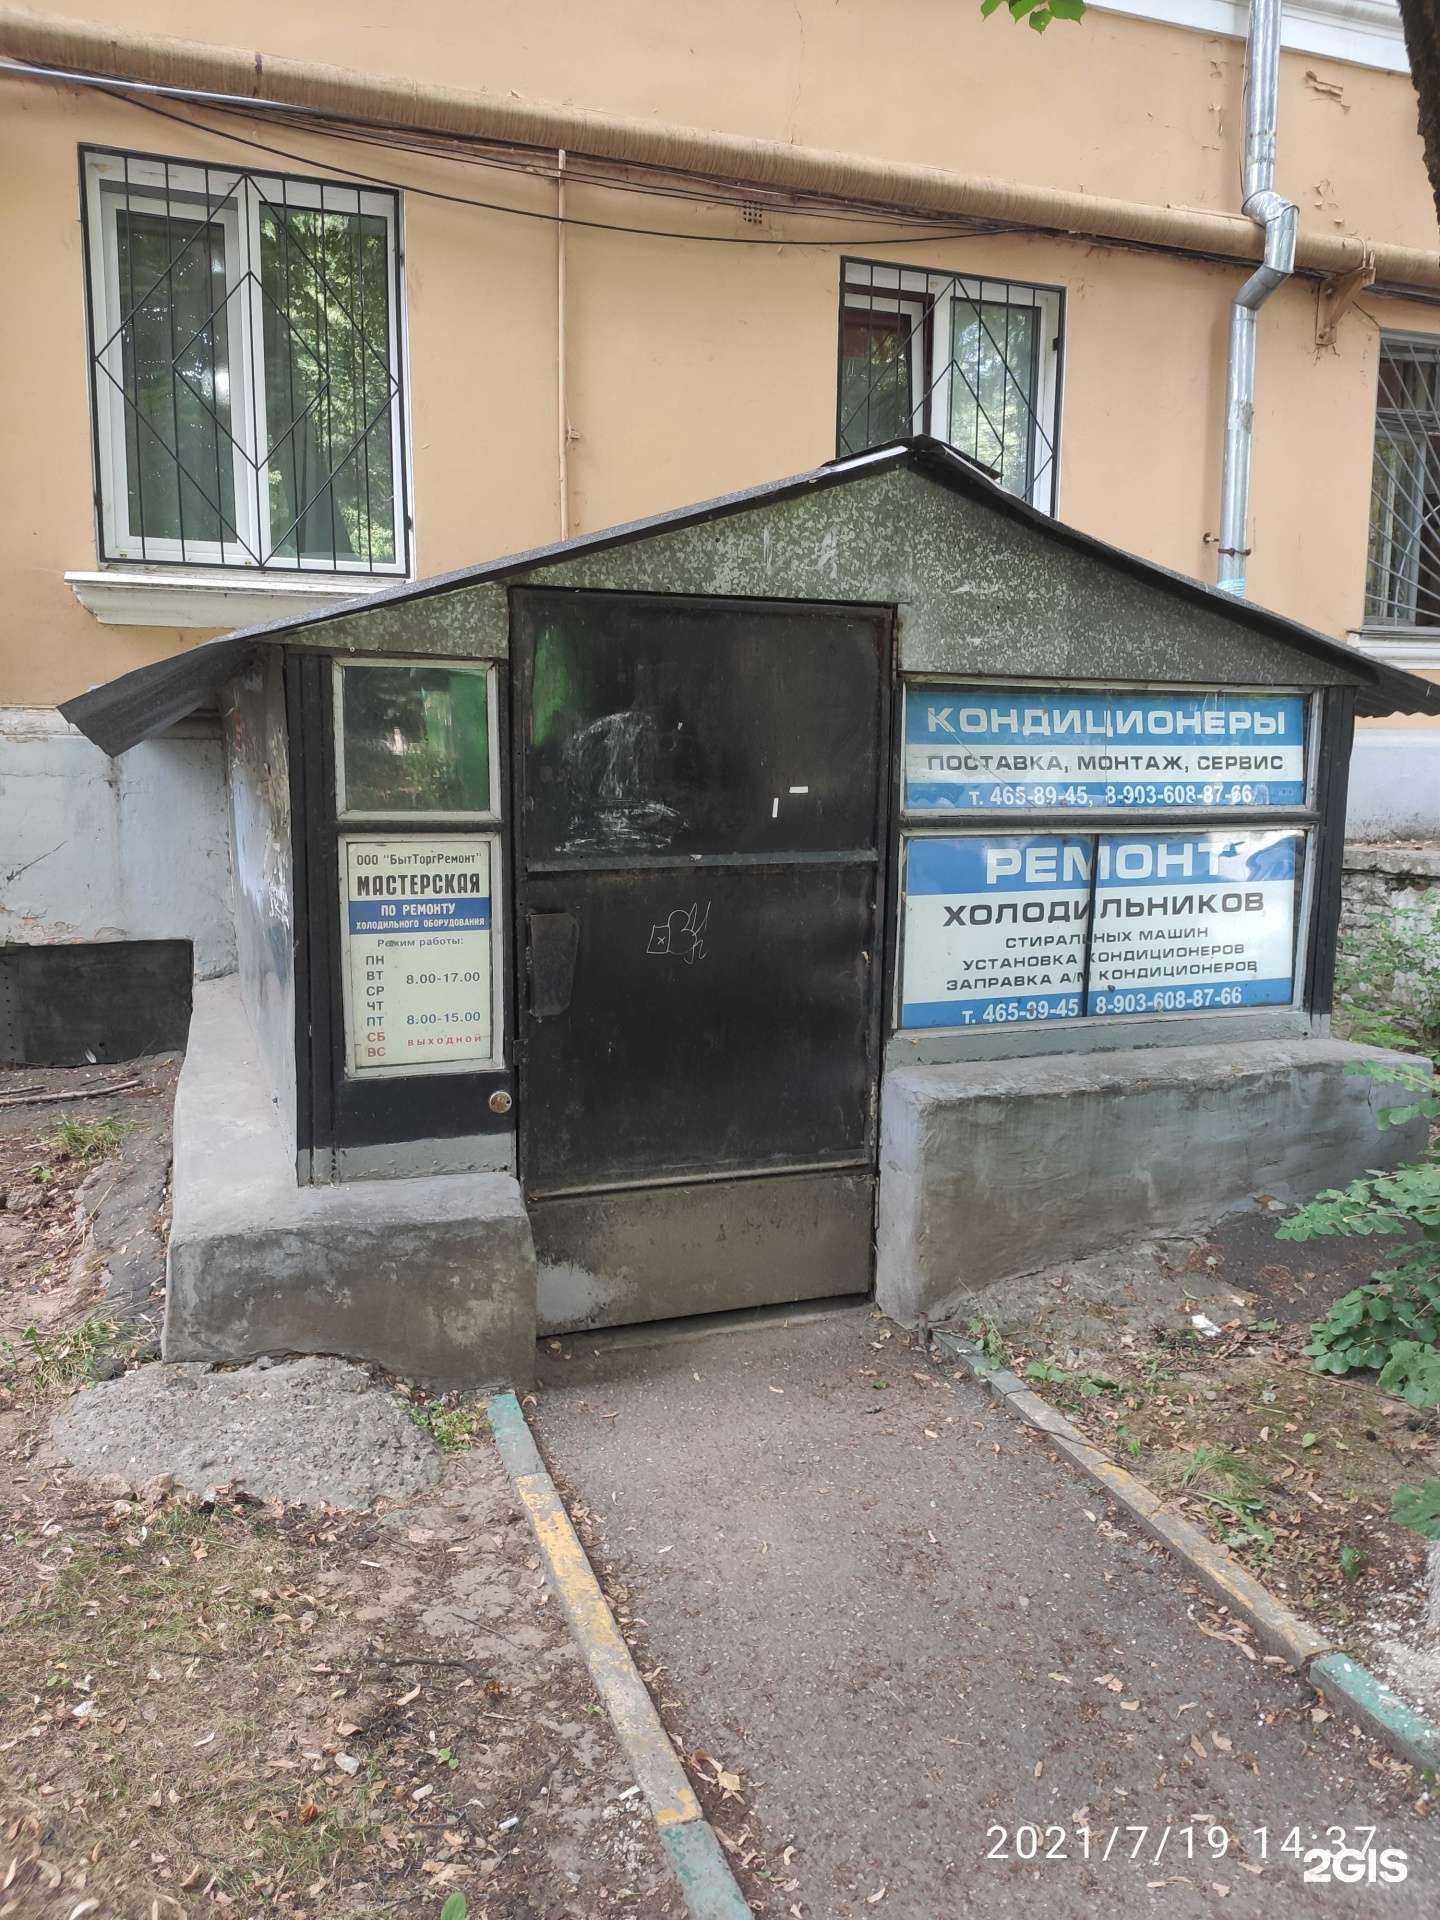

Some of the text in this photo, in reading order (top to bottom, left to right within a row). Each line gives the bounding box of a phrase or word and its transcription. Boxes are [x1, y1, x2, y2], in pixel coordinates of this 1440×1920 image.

[927, 707, 1286, 738] КОНДИЦИОНЕРЫ
[927, 755, 1284, 774] ПОСТАВКА, МОНТАЖ, СЕРВИС
[1105, 783, 1252, 805] 8-903-608-87-66
[356, 854, 379, 866] ООО
[986, 843, 1228, 886] РЕМОНТ
[357, 873, 480, 897] МАСТЕРСКАЯ
[381, 902, 456, 917] ПО РЕМОНТУ
[943, 892, 1264, 927] ХОЛОДИЛЬНИКОВ
[356, 917, 485, 931] ХОЛОДИЛЬНОГО ОБОРУДОВАНИЯ
[1139, 927, 1208, 941] МАШИН
[419, 936, 464, 948] работы:
[366, 956, 385, 966] ПН
[963, 944, 1245, 971] УСТАНОВКА КОНДИЦИОНЕРОВ
[366, 970, 480, 985] ВТ 8.00-17.00
[946, 974, 1052, 991] ЗАПРАВКА
[1099, 961, 1257, 981] КОНДИЦИОНЕРОВ
[366, 986, 385, 997] СР
[367, 1001, 384, 1012] ЧТ
[1096, 986, 1242, 1015] 8-903-608-87-66
[366, 1011, 481, 1027] ПТ 8.00-15.00
[367, 1031, 386, 1042] СБ
[367, 1047, 386, 1058] ВС
